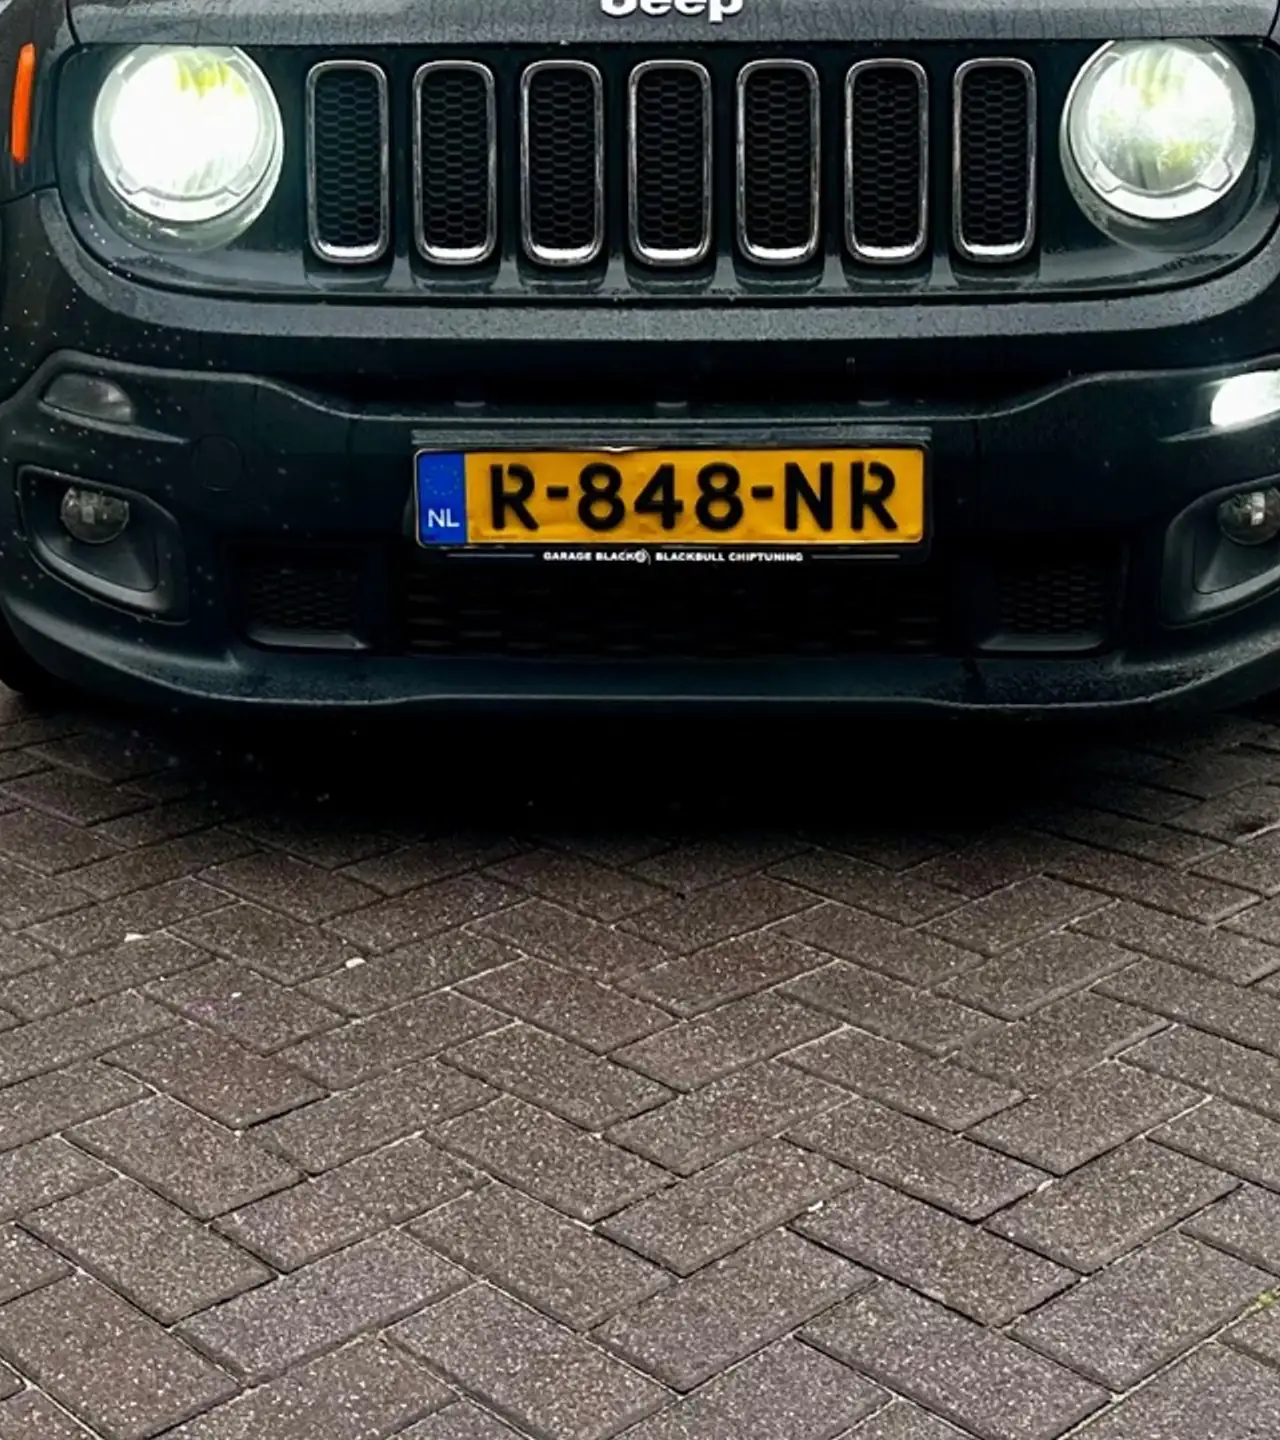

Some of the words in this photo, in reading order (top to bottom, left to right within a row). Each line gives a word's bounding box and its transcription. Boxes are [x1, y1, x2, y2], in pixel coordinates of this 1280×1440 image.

[489, 462, 899, 532] R-848-NR
[427, 507, 460, 529] NL
[542, 551, 592, 562] GARAGE
[656, 551, 725, 561] BLACKBULL
